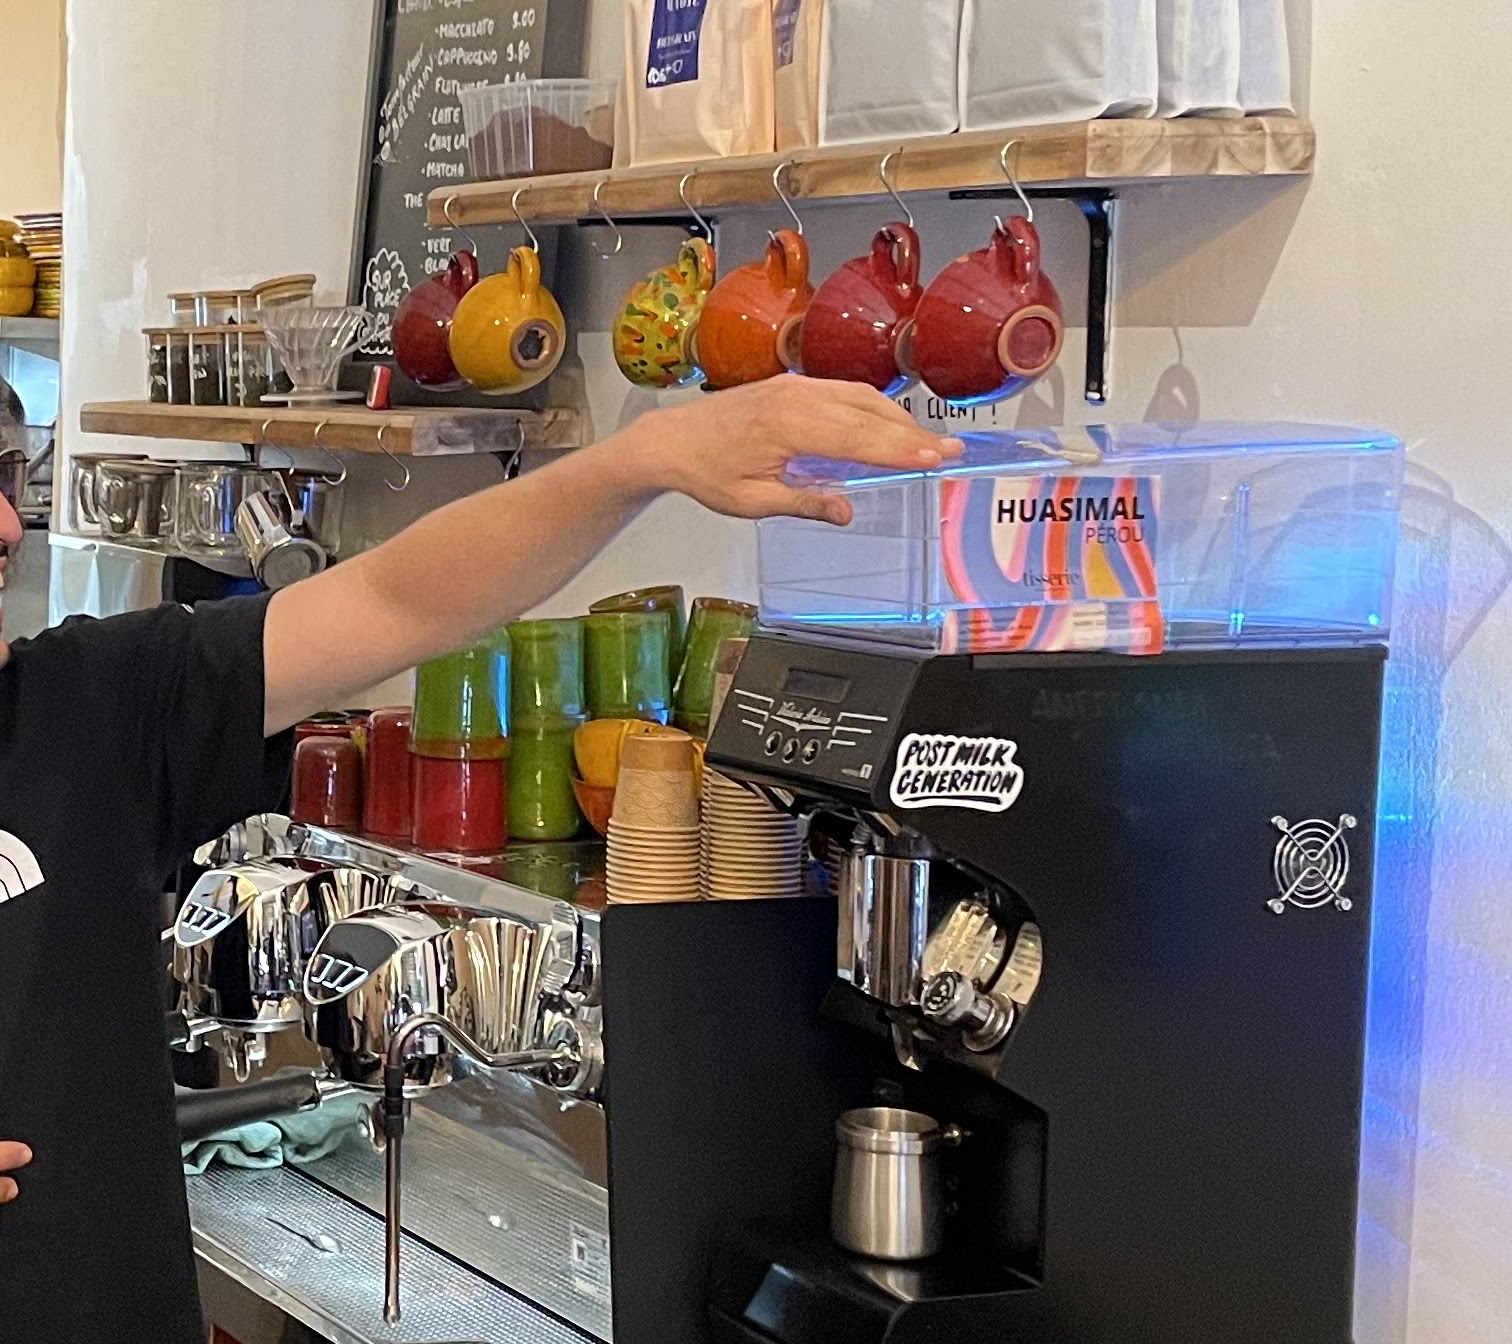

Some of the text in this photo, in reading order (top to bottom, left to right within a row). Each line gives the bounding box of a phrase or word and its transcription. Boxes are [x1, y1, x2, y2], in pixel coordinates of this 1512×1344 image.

[996, 496, 1145, 523] HUASIMAL
[902, 739, 1008, 767] POST MILK
[896, 769, 1019, 795] GENERATION
